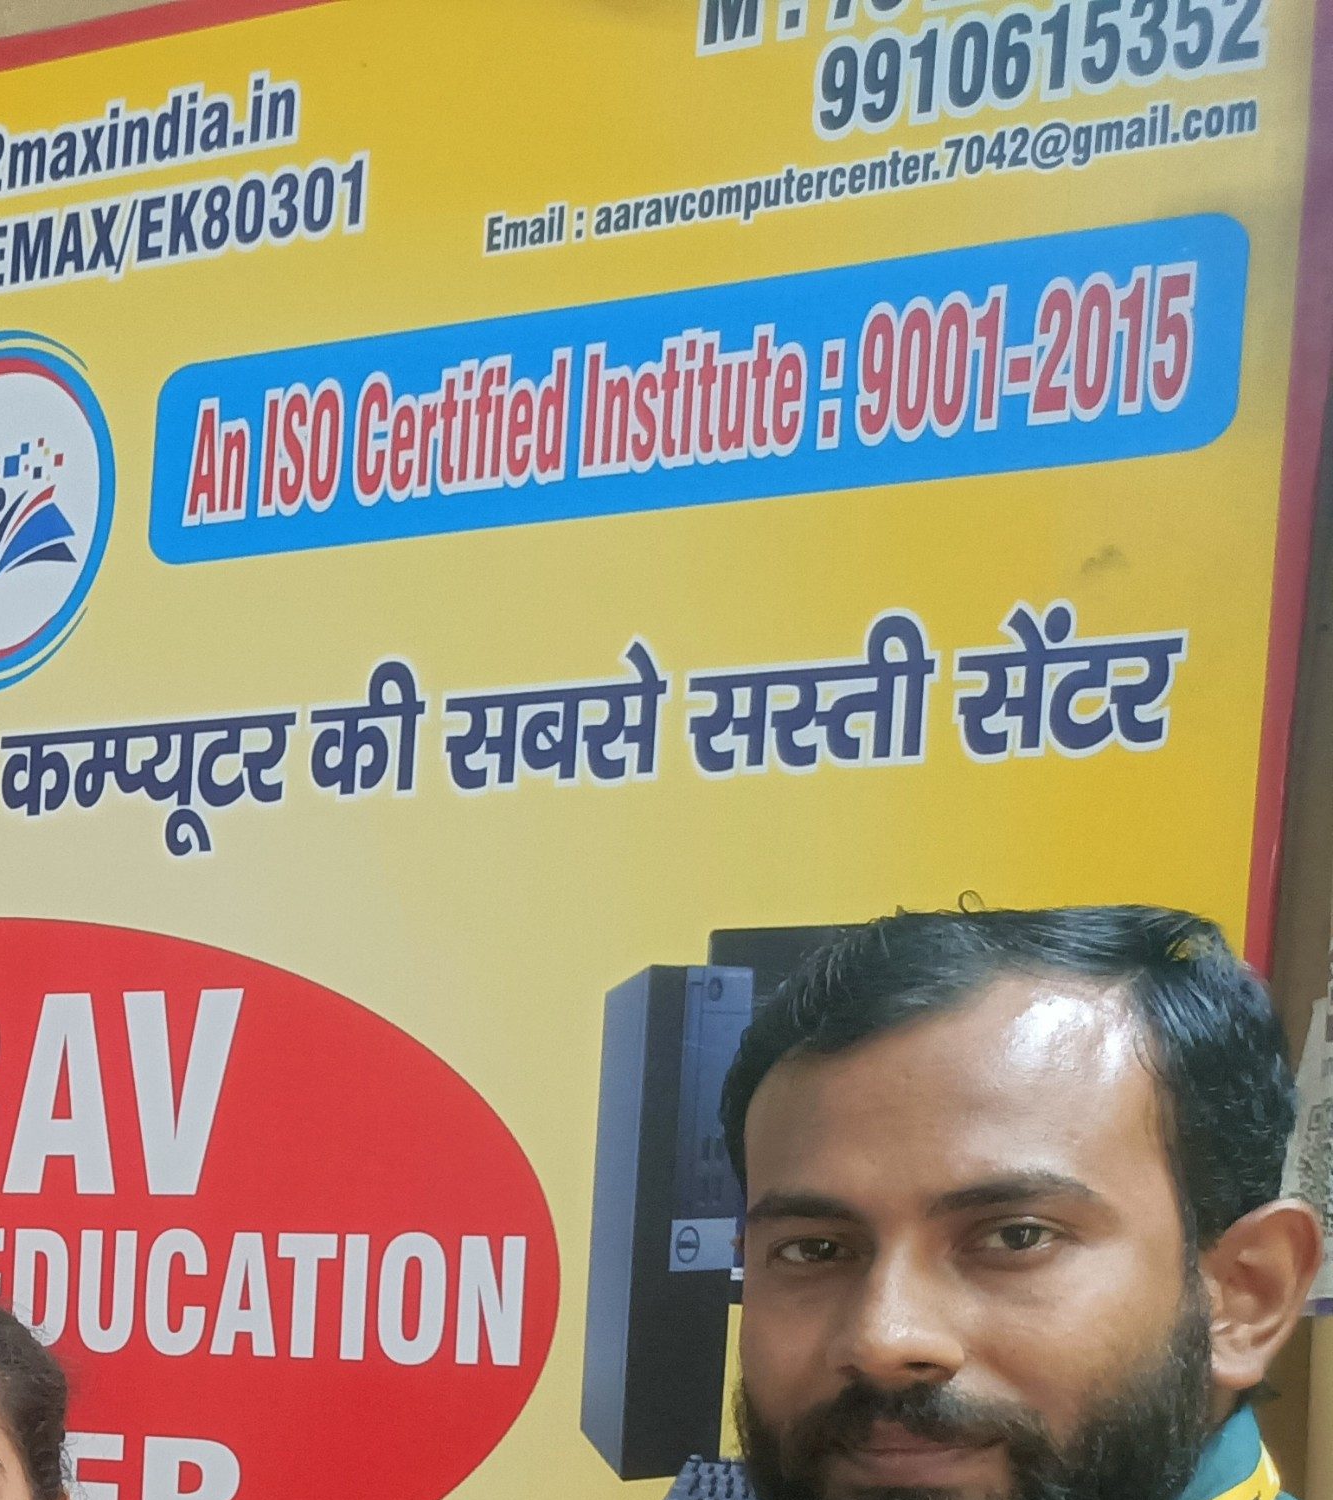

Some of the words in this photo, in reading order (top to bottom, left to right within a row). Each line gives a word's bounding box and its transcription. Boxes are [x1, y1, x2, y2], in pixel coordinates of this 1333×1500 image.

[820, 0, 1259, 131] 9910615352
[486, 204, 565, 252] Email
[594, 100, 1257, 236] aaravcomputercenter.7042@gmail.com
[188, 398, 247, 518] An
[264, 388, 335, 508] ISO
[356, 358, 568, 498] Certified
[584, 334, 803, 468] Institute
[862, 272, 1194, 438] 9001-2015
[0, 712, 297, 856] कम्प्यूटर
[310, 661, 424, 796] की
[445, 643, 667, 786] सबसे
[689, 617, 935, 774] सस्ती
[957, 606, 1185, 757] सेंटर
